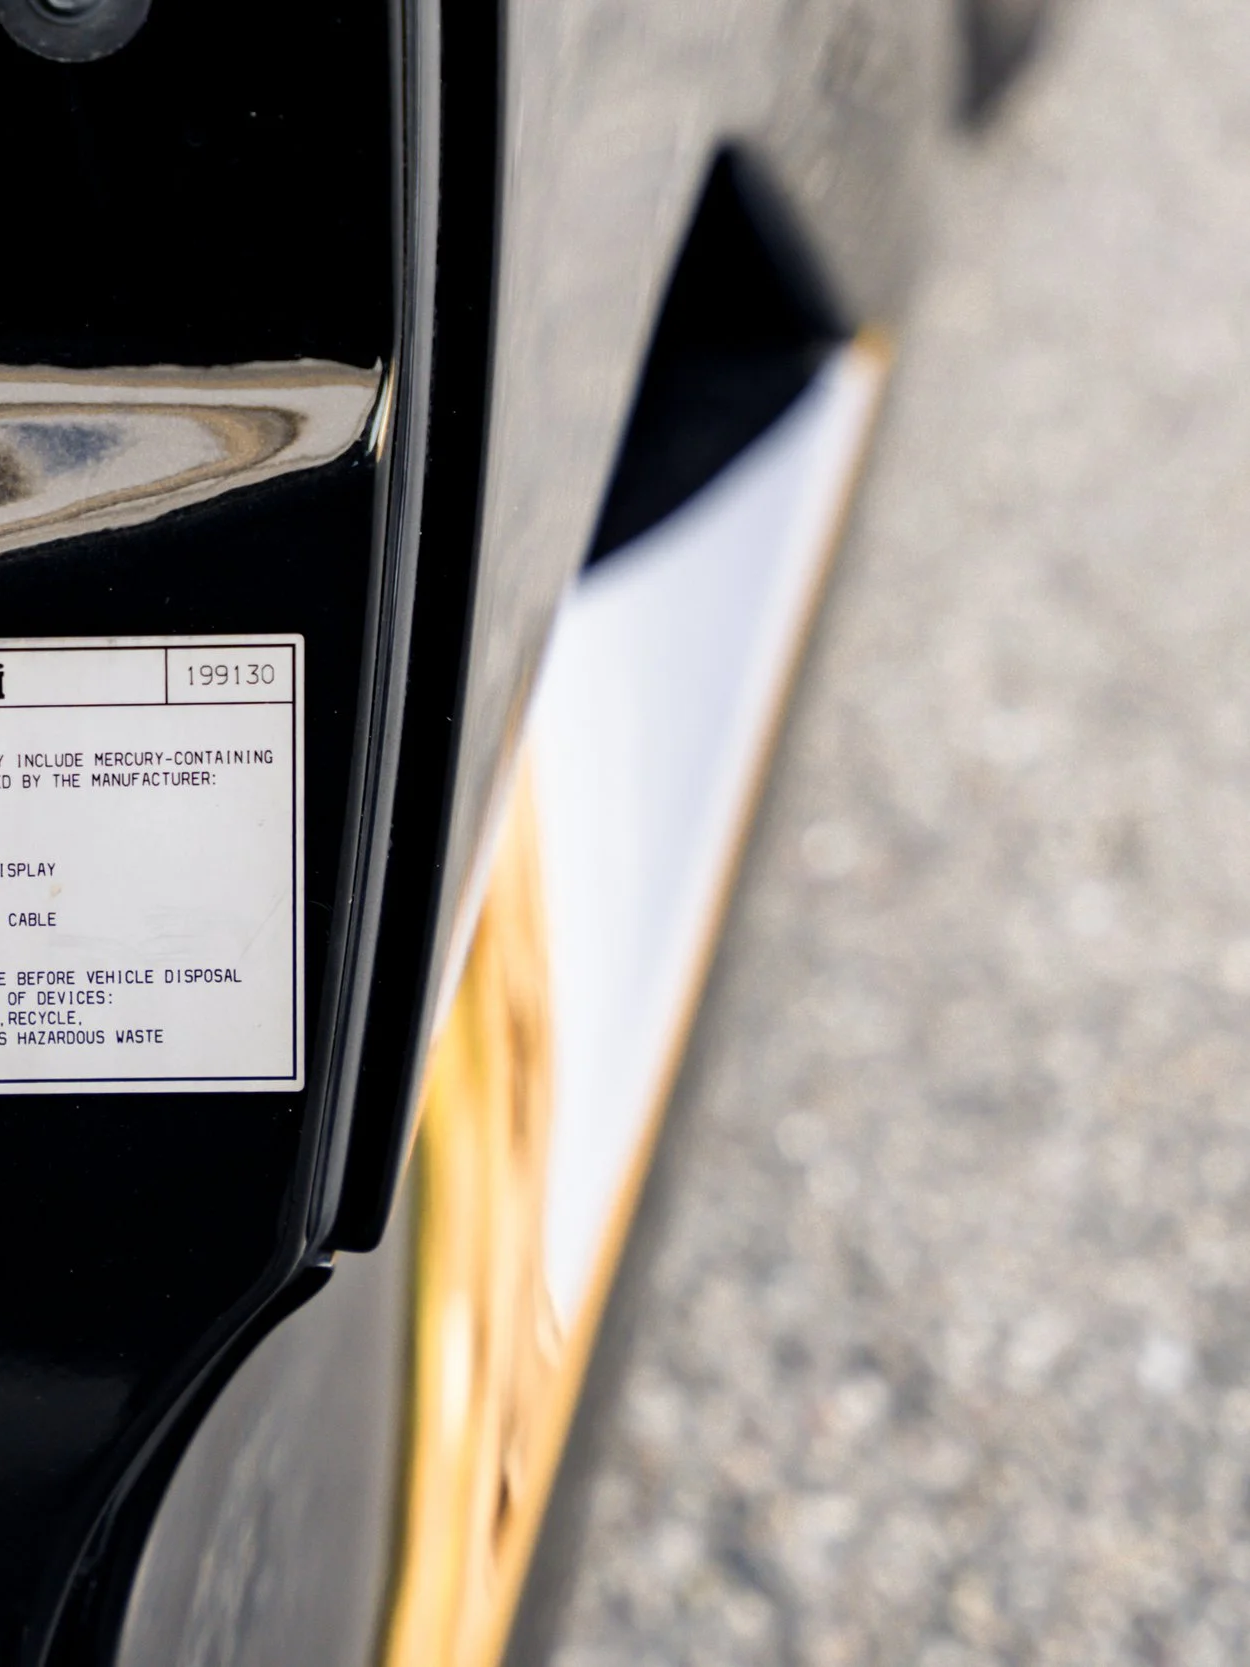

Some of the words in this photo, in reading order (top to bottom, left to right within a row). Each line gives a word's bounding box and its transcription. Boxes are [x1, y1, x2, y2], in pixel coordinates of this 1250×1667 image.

[187, 663, 275, 686] 199130
[17, 752, 84, 769] INCLUDE
[94, 749, 274, 768] MERCURY-CONTAINING
[21, 773, 41, 789] BY
[52, 773, 82, 789] THE
[91, 770, 216, 788] MANUFACTURER:
[8, 911, 57, 928] CABLE
[16, 970, 76, 987] BEFORE
[86, 969, 155, 985] VEHICLE
[164, 968, 243, 984] DISPOSAL
[7, 990, 27, 1007] OF
[36, 989, 113, 1006] DEVICES:
[17, 1029, 106, 1046] HAZARDOUS
[115, 1028, 164, 1045] WASTE
